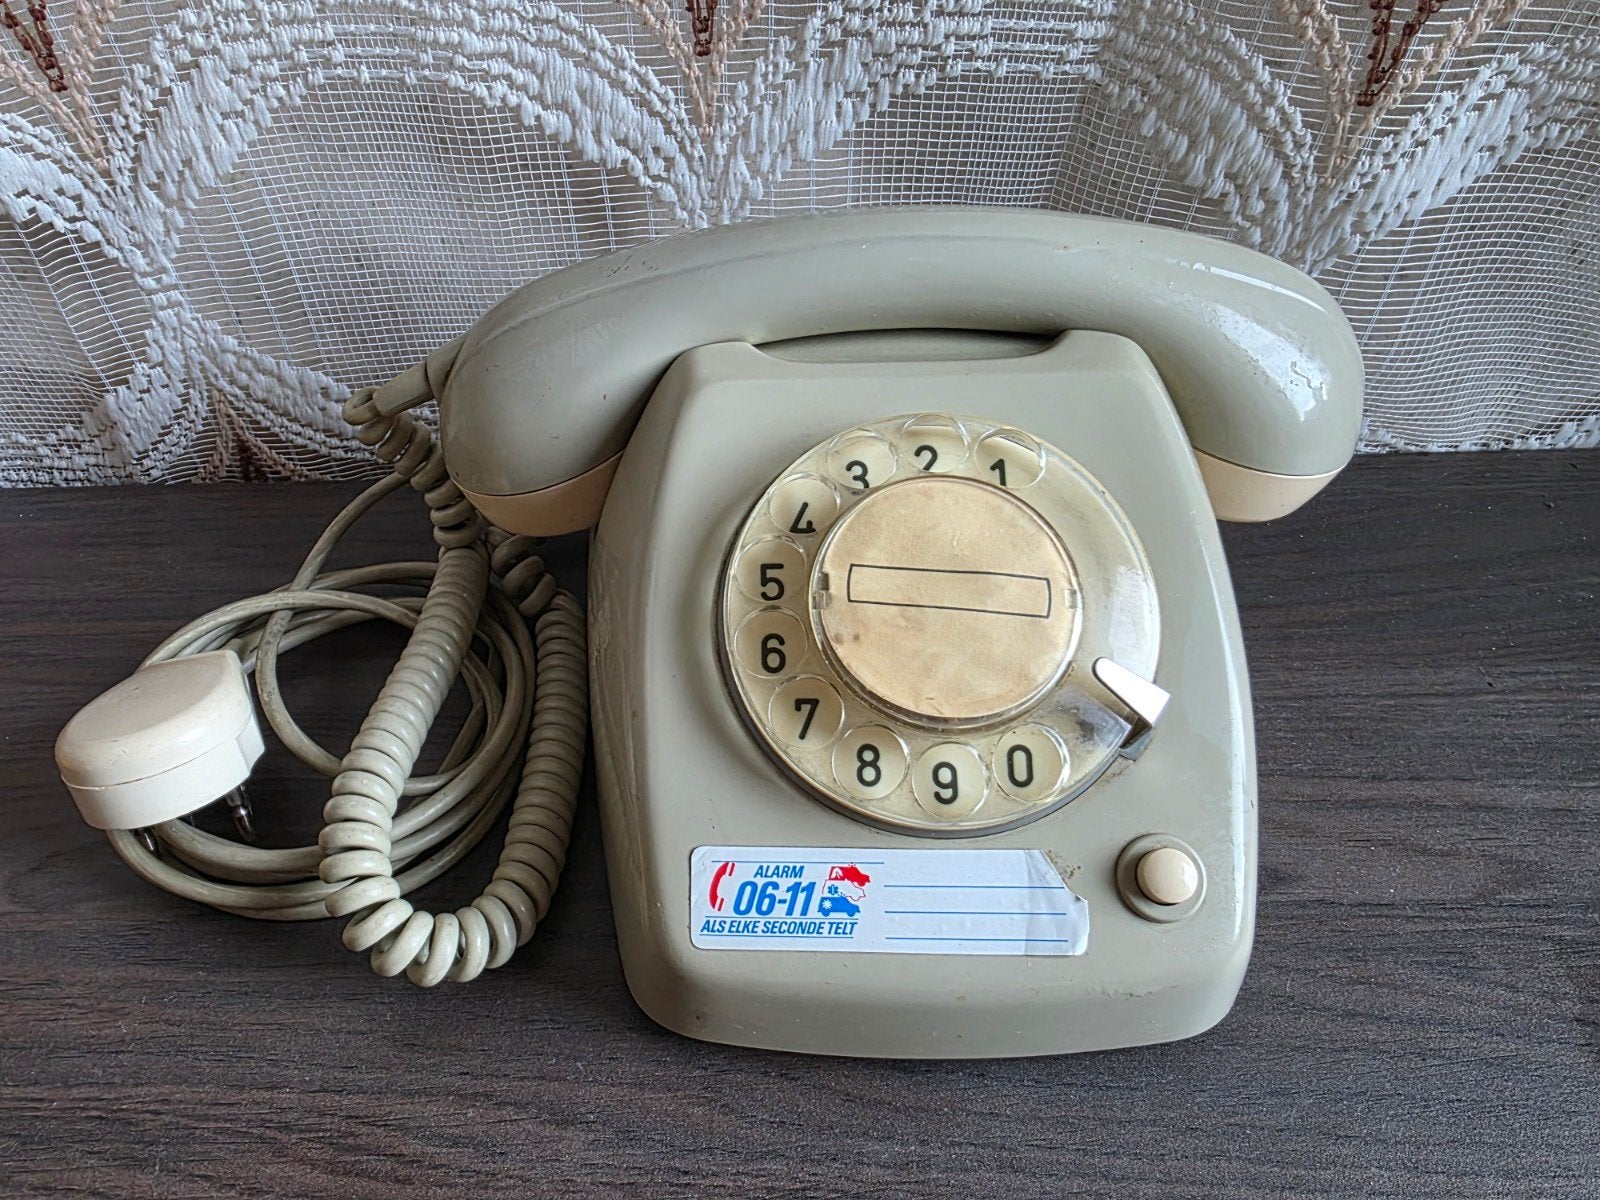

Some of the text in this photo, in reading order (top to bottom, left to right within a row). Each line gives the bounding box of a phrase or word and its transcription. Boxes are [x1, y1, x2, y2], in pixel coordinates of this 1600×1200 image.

[845, 460, 870, 489] 3
[914, 445, 939, 471] 2
[990, 458, 1007, 487] 1
[789, 501, 817, 534] 4
[760, 563, 785, 601] 5
[760, 633, 787, 674] 6
[794, 697, 820, 740] 7
[856, 743, 882, 787] 8
[931, 761, 959, 805] 9
[1006, 744, 1034, 788] 0
[753, 865, 805, 878] ALARM
[732, 880, 817, 917] 06-11
[701, 919, 858, 936] ALS ELKE SECONDE TELT
